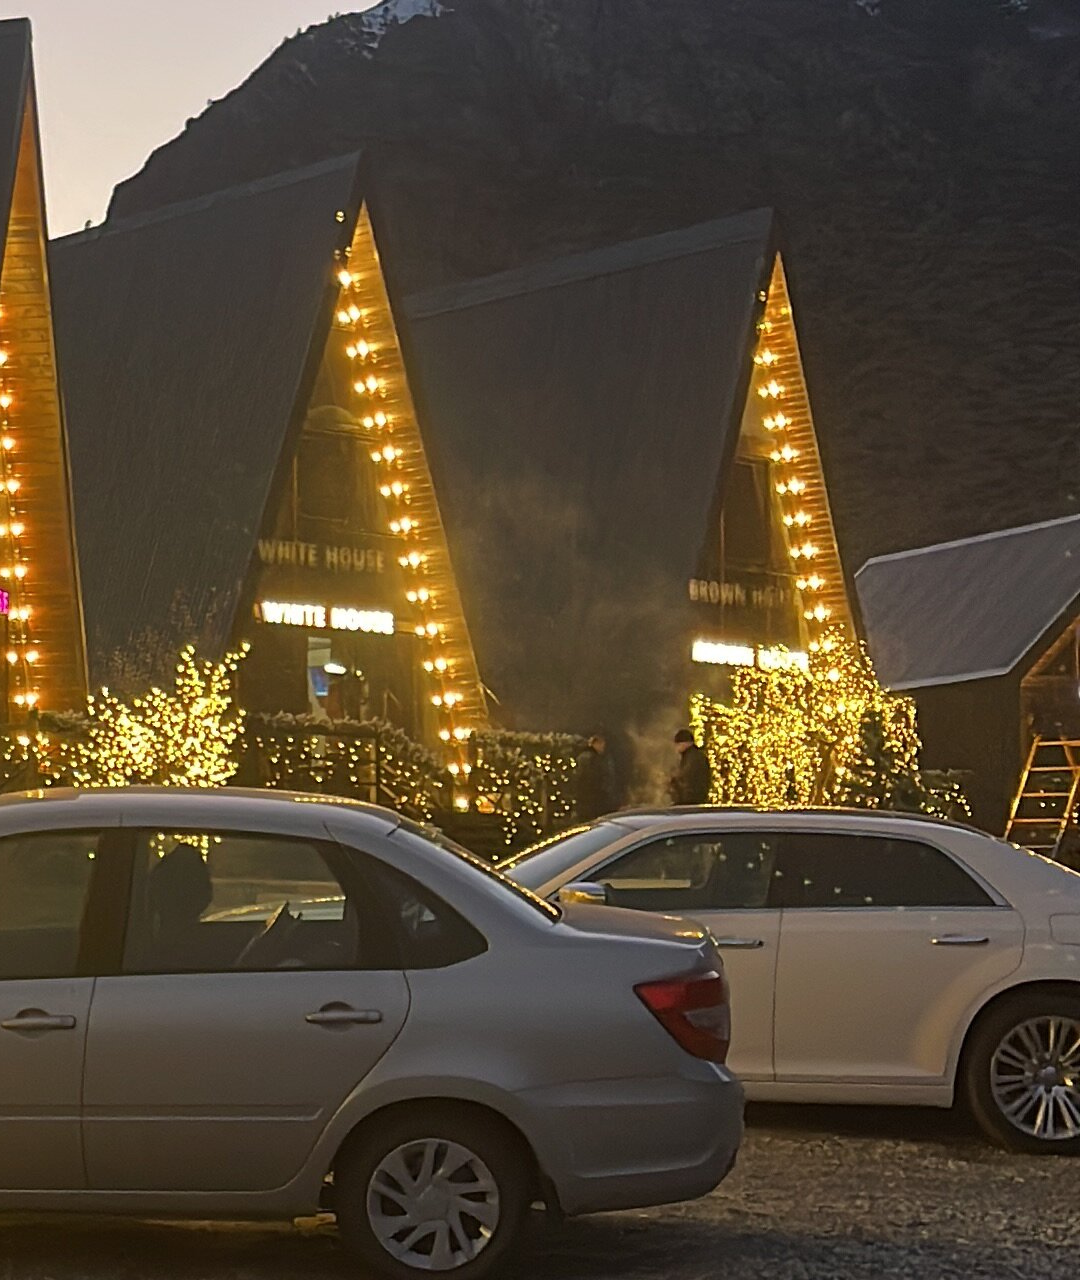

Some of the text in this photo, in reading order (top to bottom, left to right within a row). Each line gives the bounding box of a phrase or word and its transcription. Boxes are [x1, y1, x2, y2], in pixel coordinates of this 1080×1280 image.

[258, 539, 384, 573] WHITE HOUSE
[690, 579, 746, 606] BROWN
